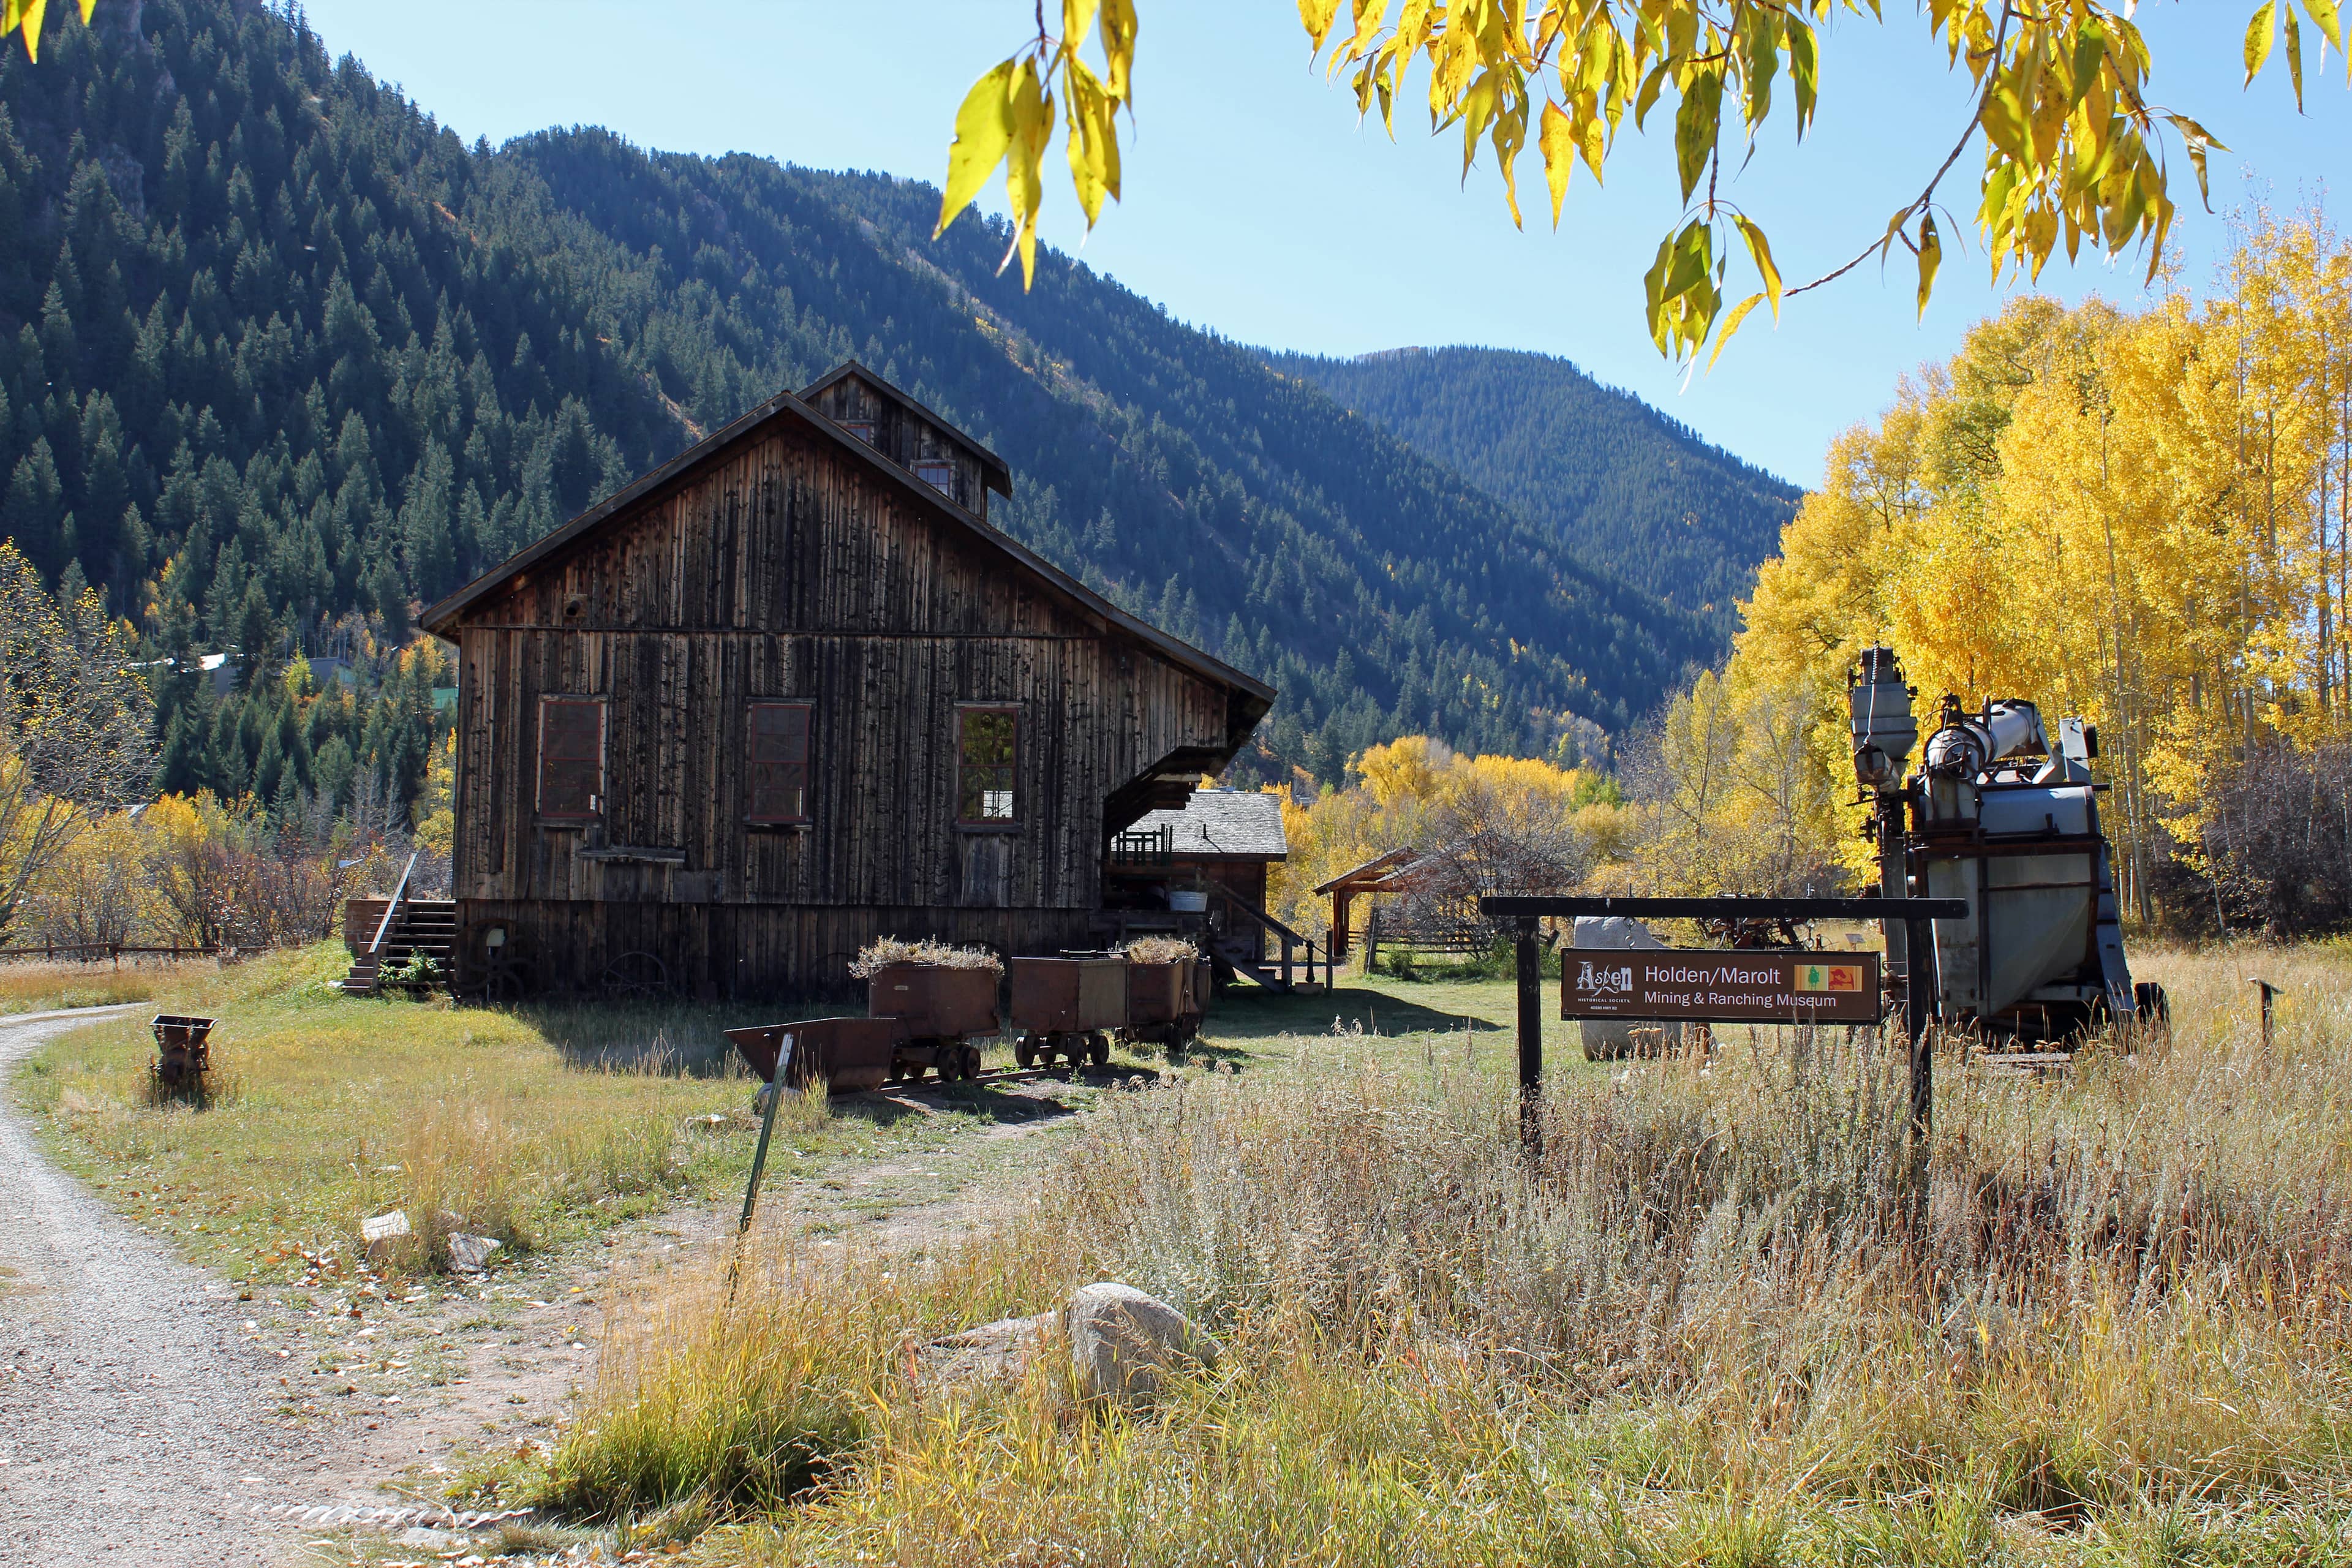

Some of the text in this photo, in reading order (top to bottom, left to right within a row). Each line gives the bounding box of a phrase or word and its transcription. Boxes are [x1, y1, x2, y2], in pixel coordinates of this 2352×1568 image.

[1576, 961, 1633, 997] Aspen
[1645, 966, 1781, 987] Holden/Marolt
[1645, 991, 1836, 1008] Mining & Ranching Museum
